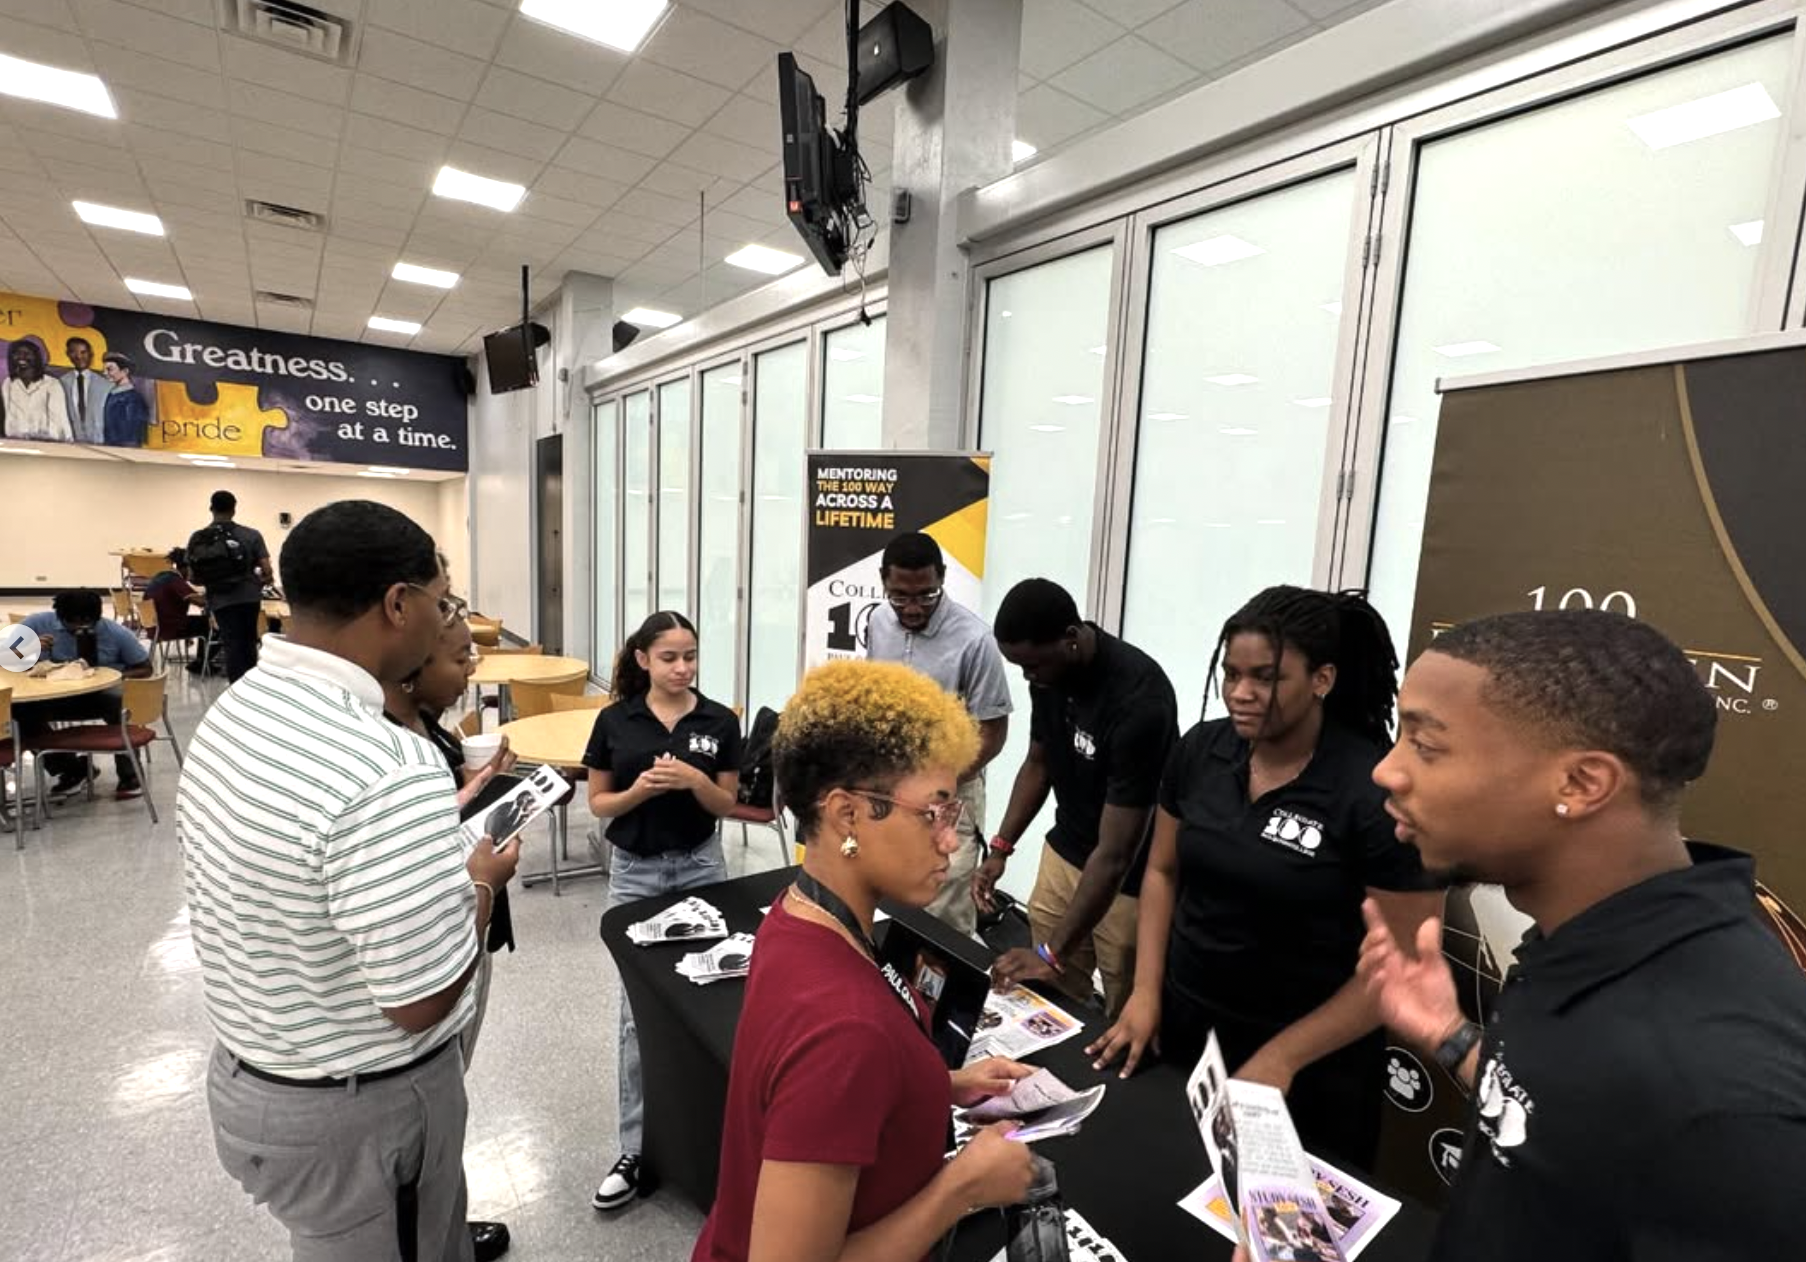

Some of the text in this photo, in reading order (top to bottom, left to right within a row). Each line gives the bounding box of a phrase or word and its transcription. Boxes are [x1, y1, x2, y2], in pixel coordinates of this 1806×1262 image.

[306, 395, 418, 423] one step
[162, 417, 241, 443] pride
[337, 422, 457, 450] at a time.
[817, 467, 898, 482] MENTORING
[816, 480, 894, 494] THE 100 WAY
[815, 493, 893, 510] ACROSS A
[815, 509, 895, 530] LIFETIME
[1715, 695, 1752, 714] NC.
